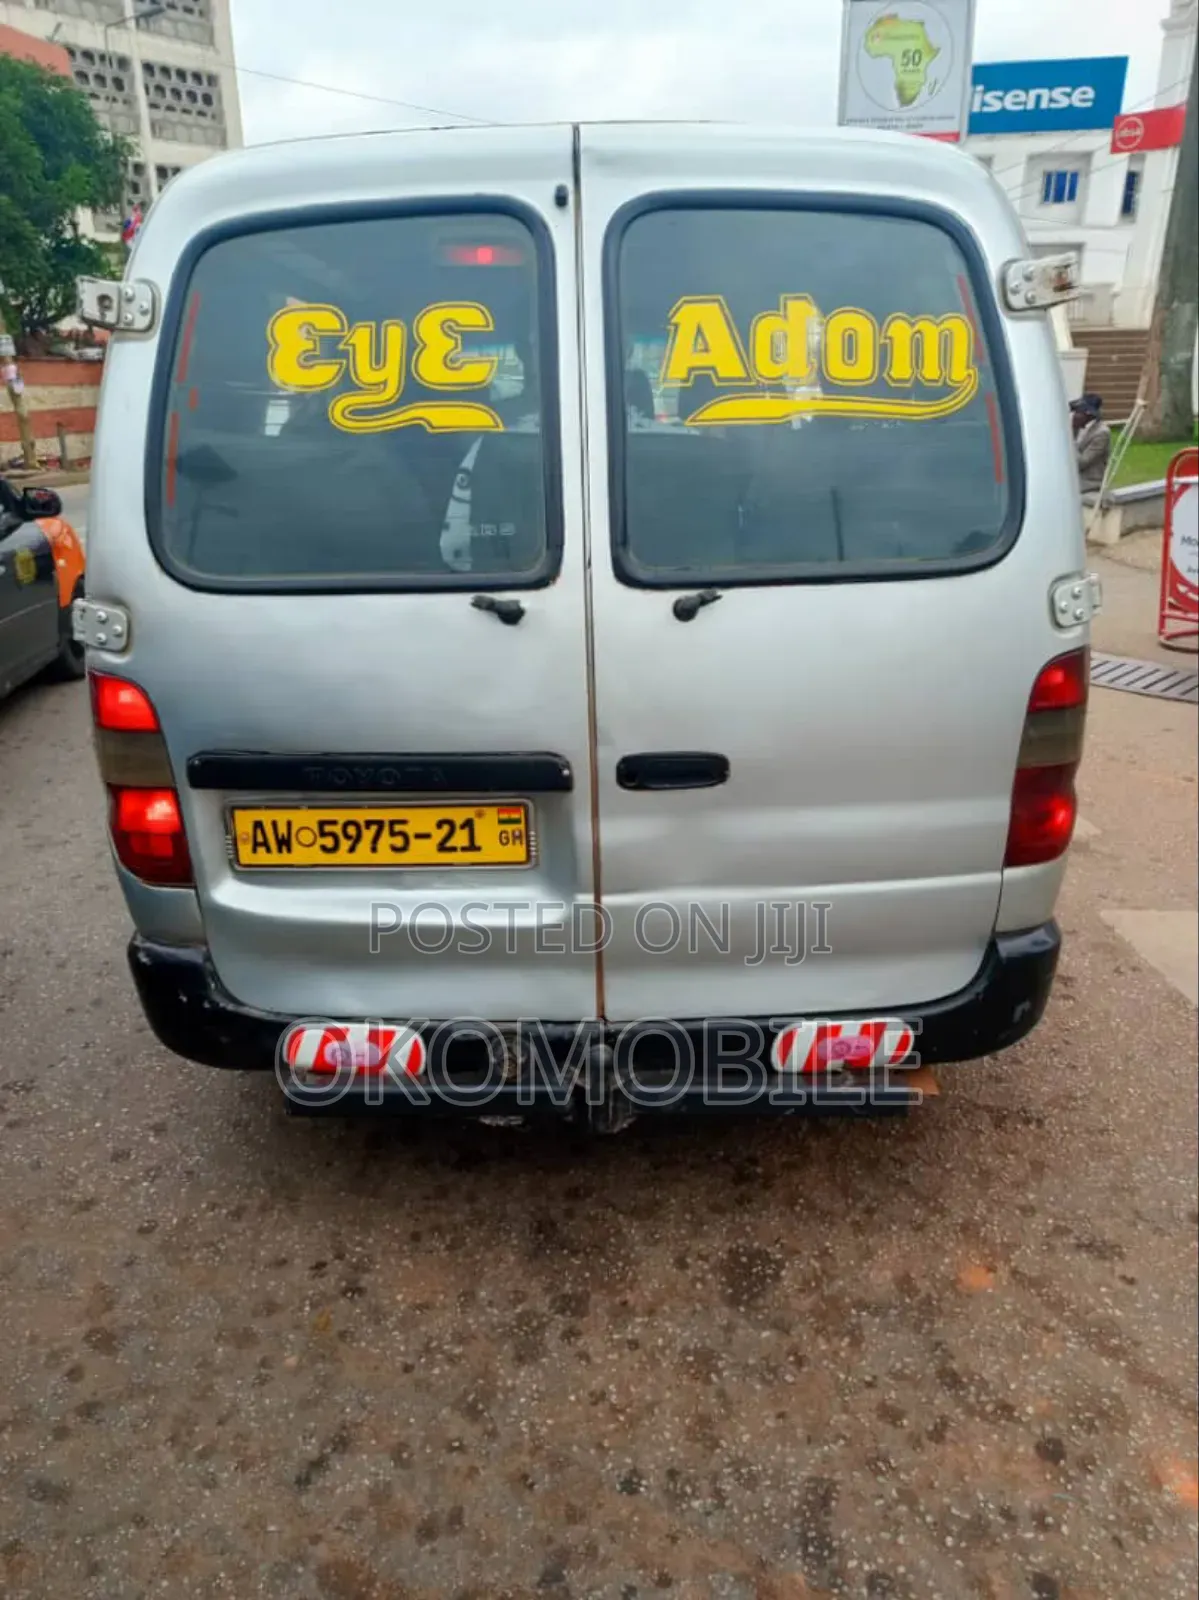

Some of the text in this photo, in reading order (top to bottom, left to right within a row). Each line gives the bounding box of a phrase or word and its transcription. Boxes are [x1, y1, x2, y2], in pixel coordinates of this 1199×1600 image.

[901, 49, 922, 67] 50
[972, 85, 1095, 113] isense
[659, 293, 979, 426] Adom
[319, 819, 482, 854] 5975-21
